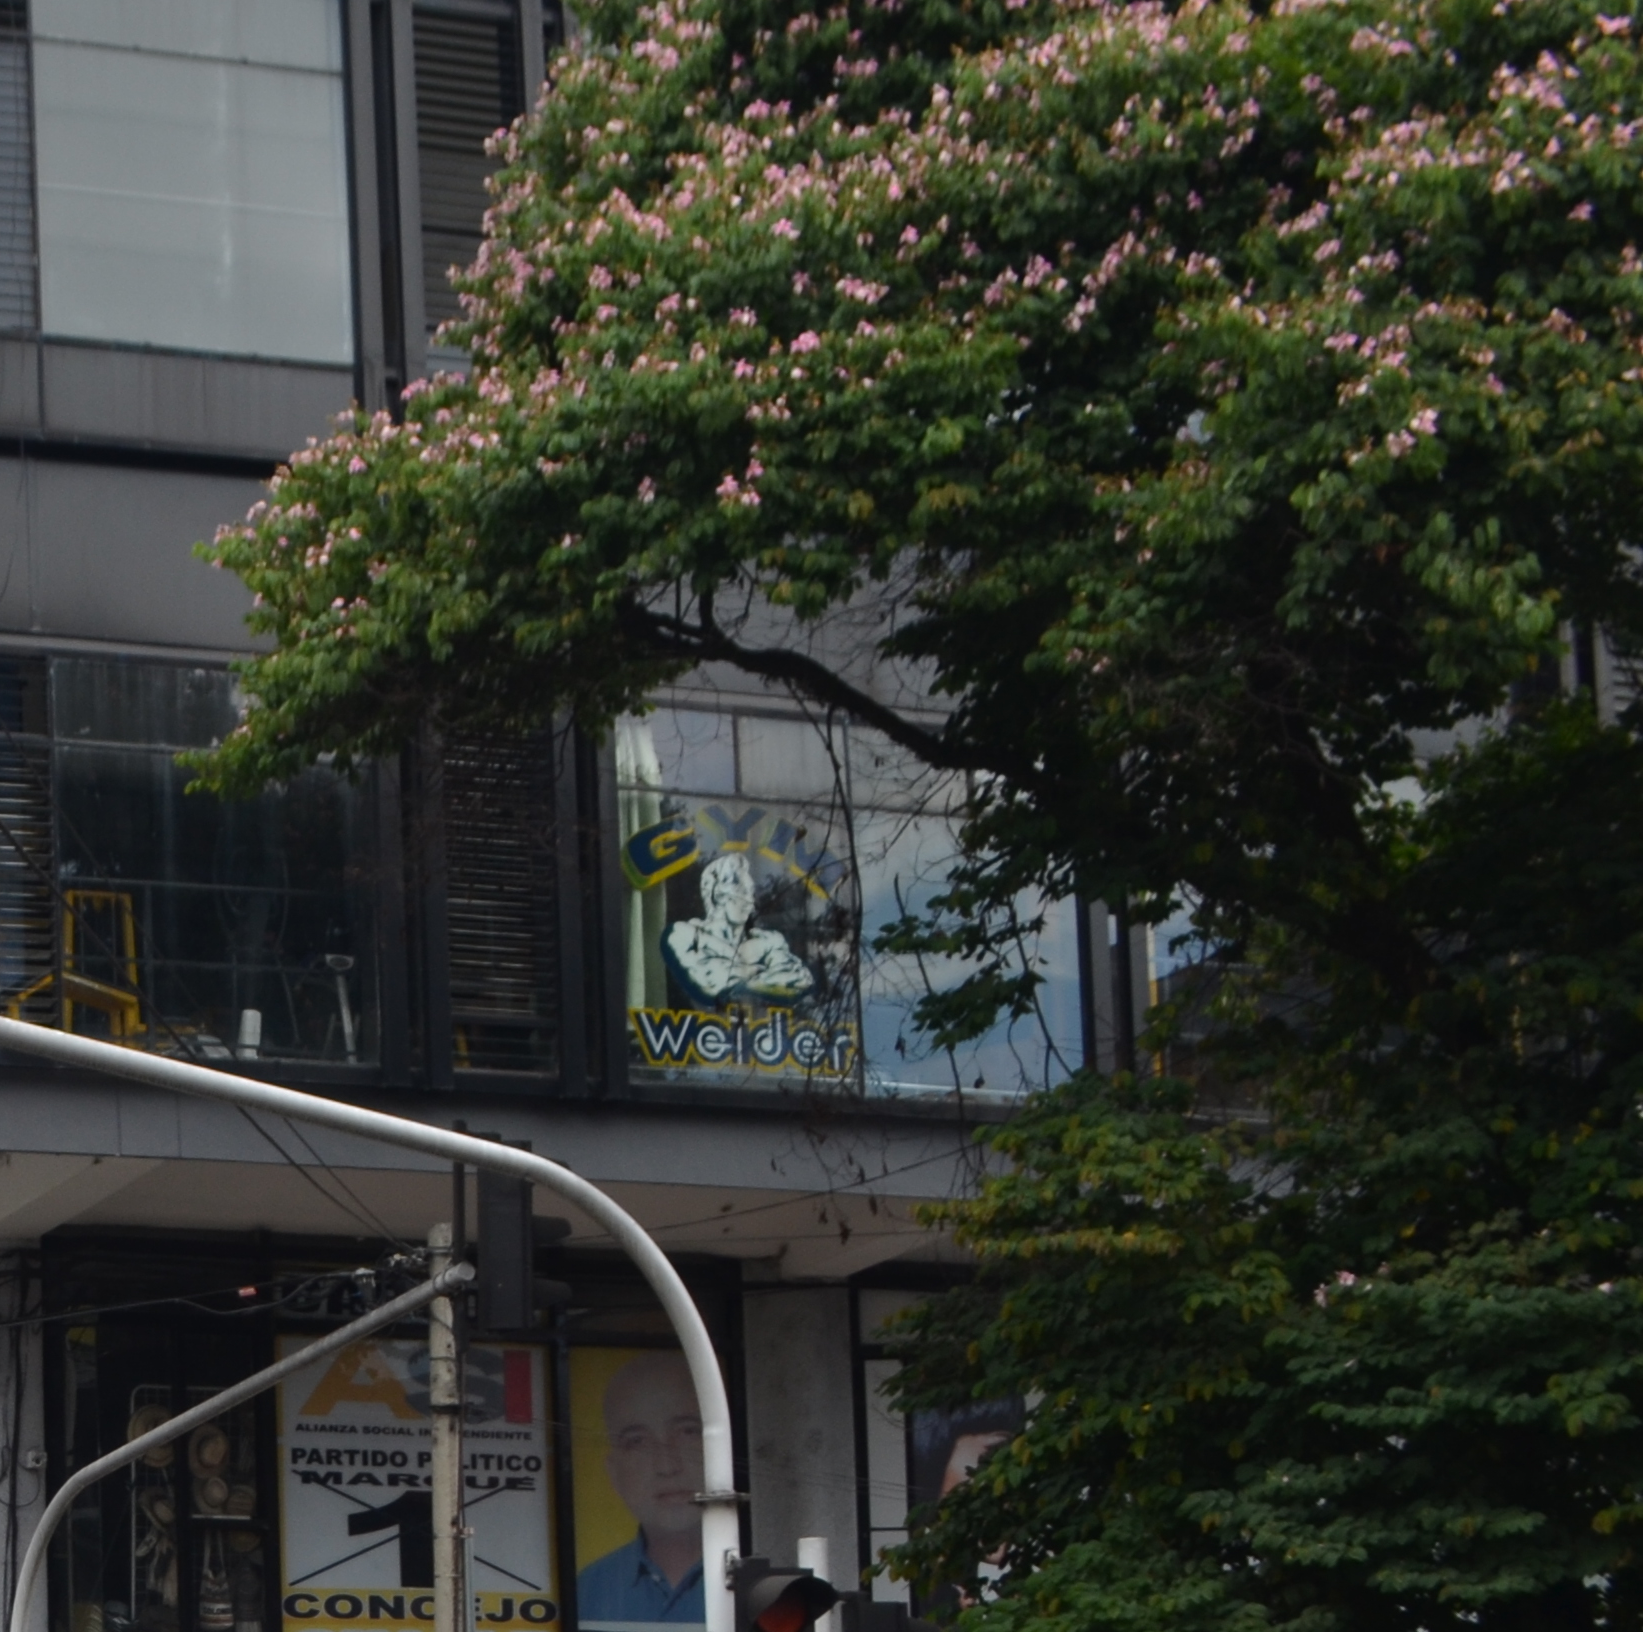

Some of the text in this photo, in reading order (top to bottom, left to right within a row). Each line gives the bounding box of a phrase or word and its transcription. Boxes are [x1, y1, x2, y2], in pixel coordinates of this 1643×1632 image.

[295, 1423, 533, 1441] ALIANZA SOCIAL INENDIENTE
[291, 1448, 542, 1473] PARTIDO PITICO
[283, 1593, 557, 1624] CONCJO
